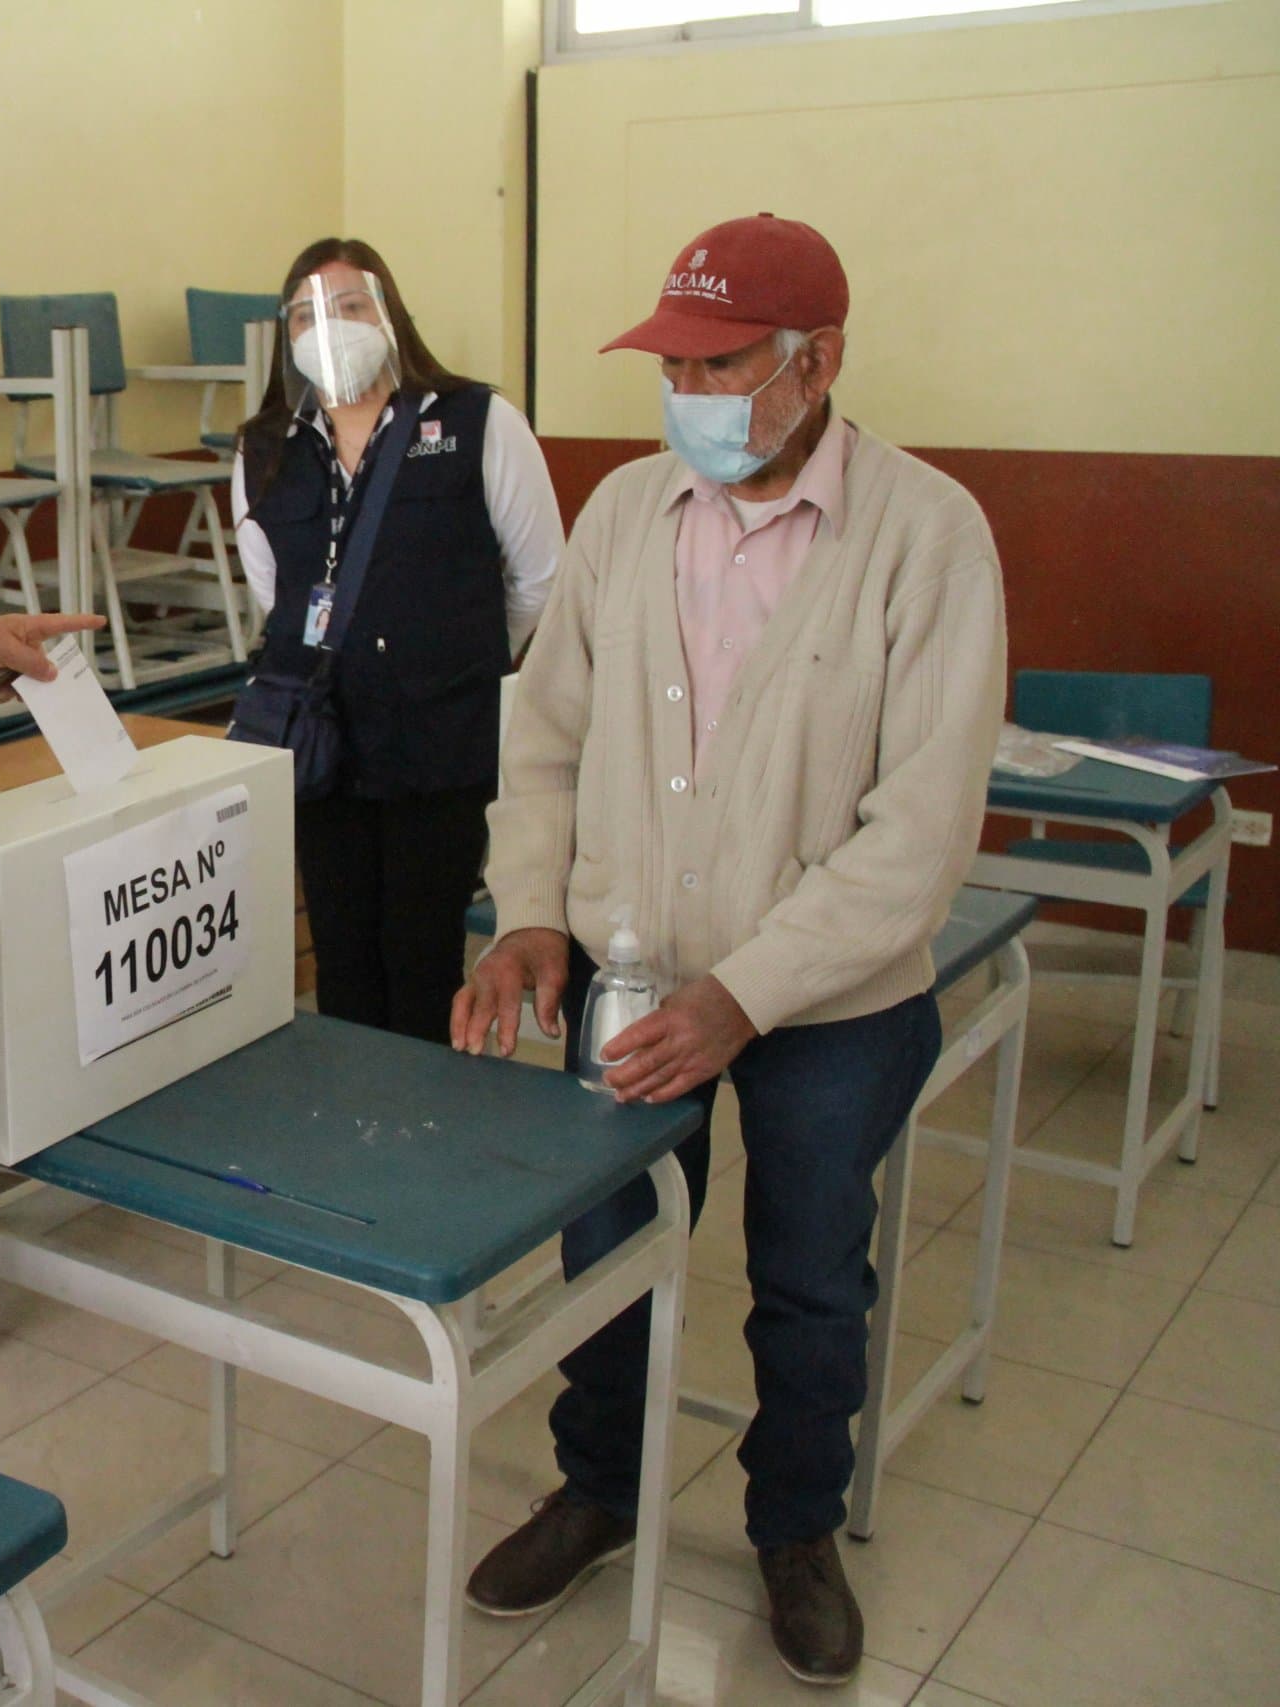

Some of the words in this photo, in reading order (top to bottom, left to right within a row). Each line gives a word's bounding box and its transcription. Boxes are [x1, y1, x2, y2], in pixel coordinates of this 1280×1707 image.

[664, 272, 727, 295] ACAMA
[103, 859, 191, 926] MESA
[95, 890, 239, 1006] 110034
